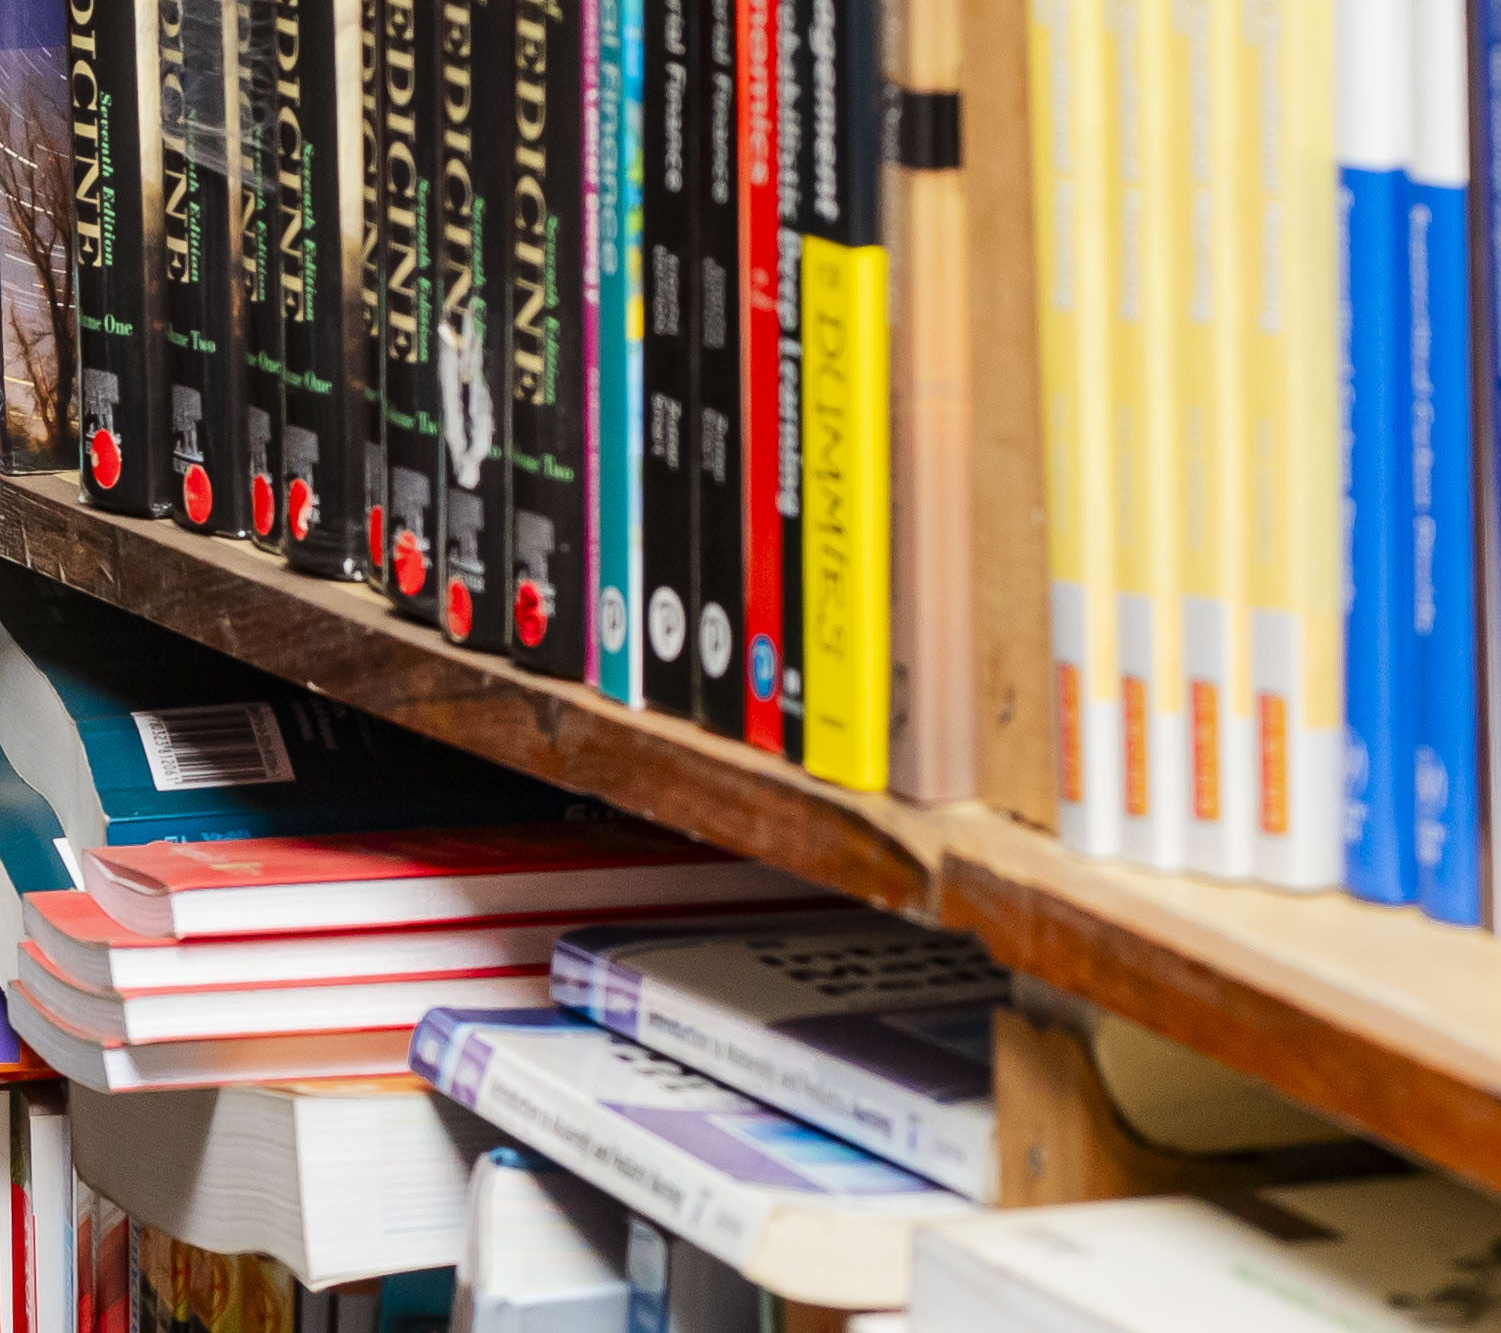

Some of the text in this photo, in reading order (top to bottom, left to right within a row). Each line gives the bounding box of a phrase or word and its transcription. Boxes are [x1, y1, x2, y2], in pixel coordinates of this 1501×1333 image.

[100, 91, 116, 267] Seventh Edition
[599, 62, 622, 276] Finance
[665, 62, 686, 193] Finance
[712, 73, 732, 205] Finance
[103, 318, 133, 337] One
[191, 329, 217, 353] Two
[777, 227, 801, 330] Deep
[774, 337, 803, 518] Learning
